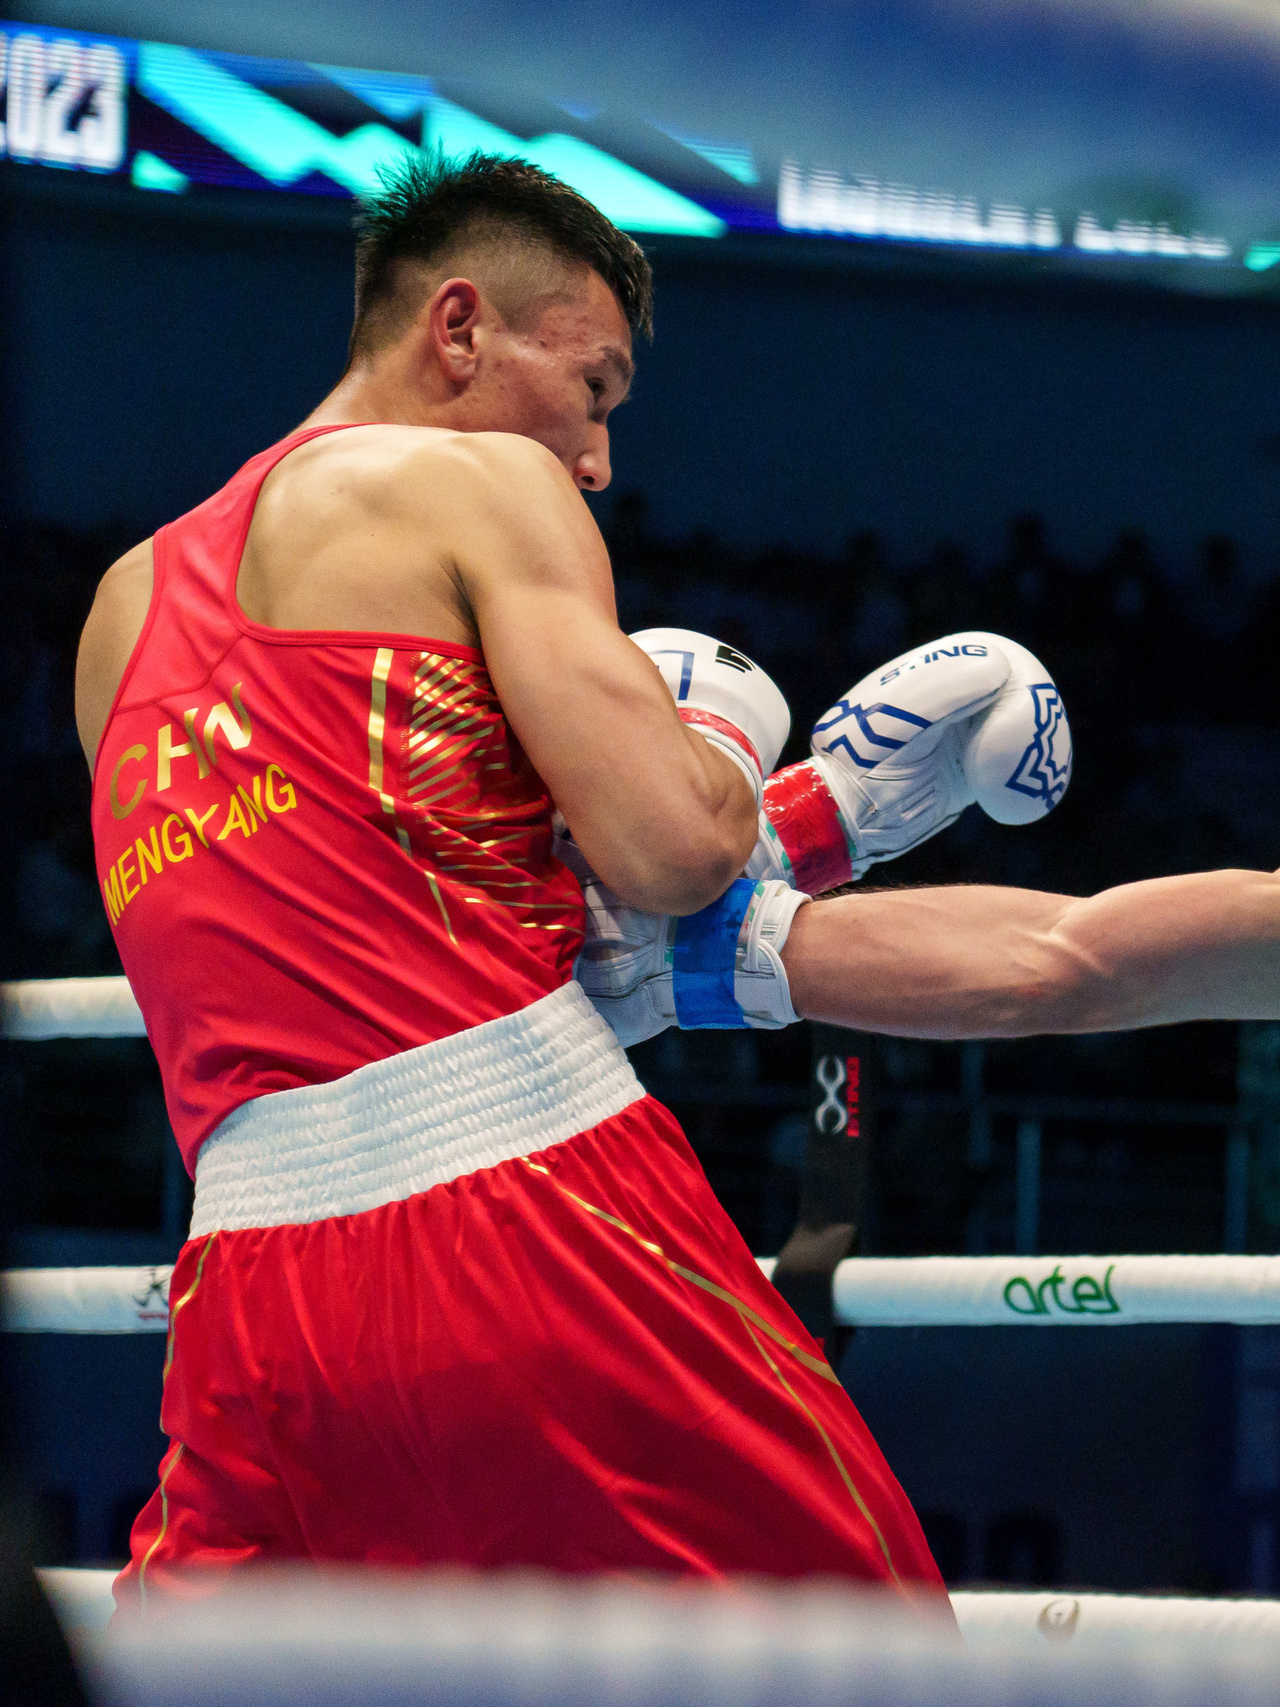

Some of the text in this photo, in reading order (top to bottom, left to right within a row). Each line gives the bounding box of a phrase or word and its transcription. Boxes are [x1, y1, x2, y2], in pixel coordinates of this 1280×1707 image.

[0, 33, 125, 168] 023
[880, 645, 988, 686] SING
[109, 682, 252, 820] CHN
[103, 764, 297, 926] MENGYANG
[1003, 1264, 1120, 1314] artel
